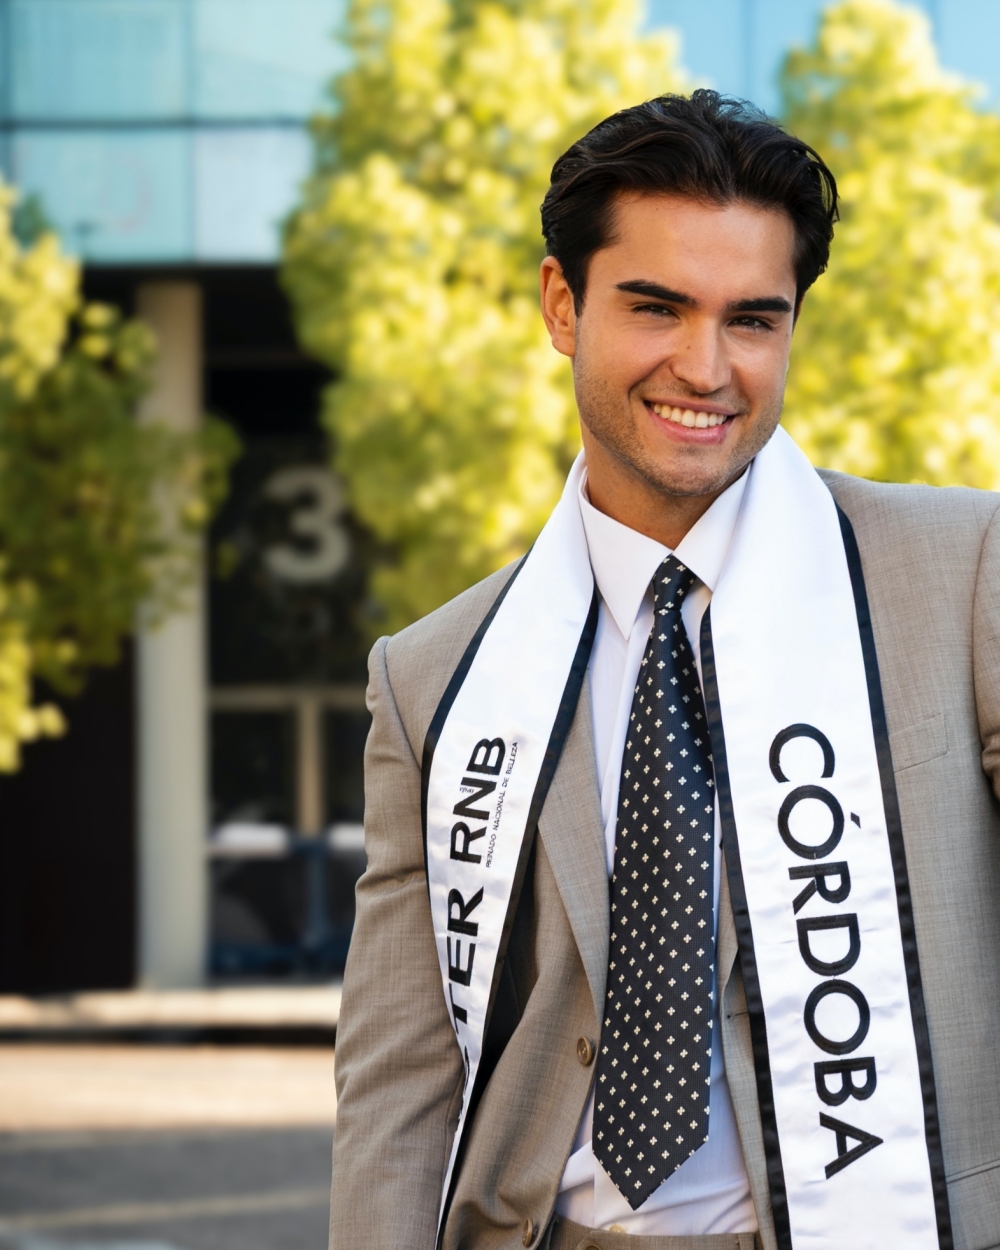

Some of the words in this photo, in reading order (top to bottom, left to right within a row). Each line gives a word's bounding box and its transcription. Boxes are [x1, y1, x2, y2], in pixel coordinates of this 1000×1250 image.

[264, 464, 350, 583] 3
[505, 741, 518, 775] BELLEZA
[449, 736, 506, 865] RNB
[501, 776, 510, 788] DE
[492, 790, 506, 832] NACIONAL
[485, 833, 497, 869] REINADO
[768, 722, 884, 1181] CÓRDOBA
